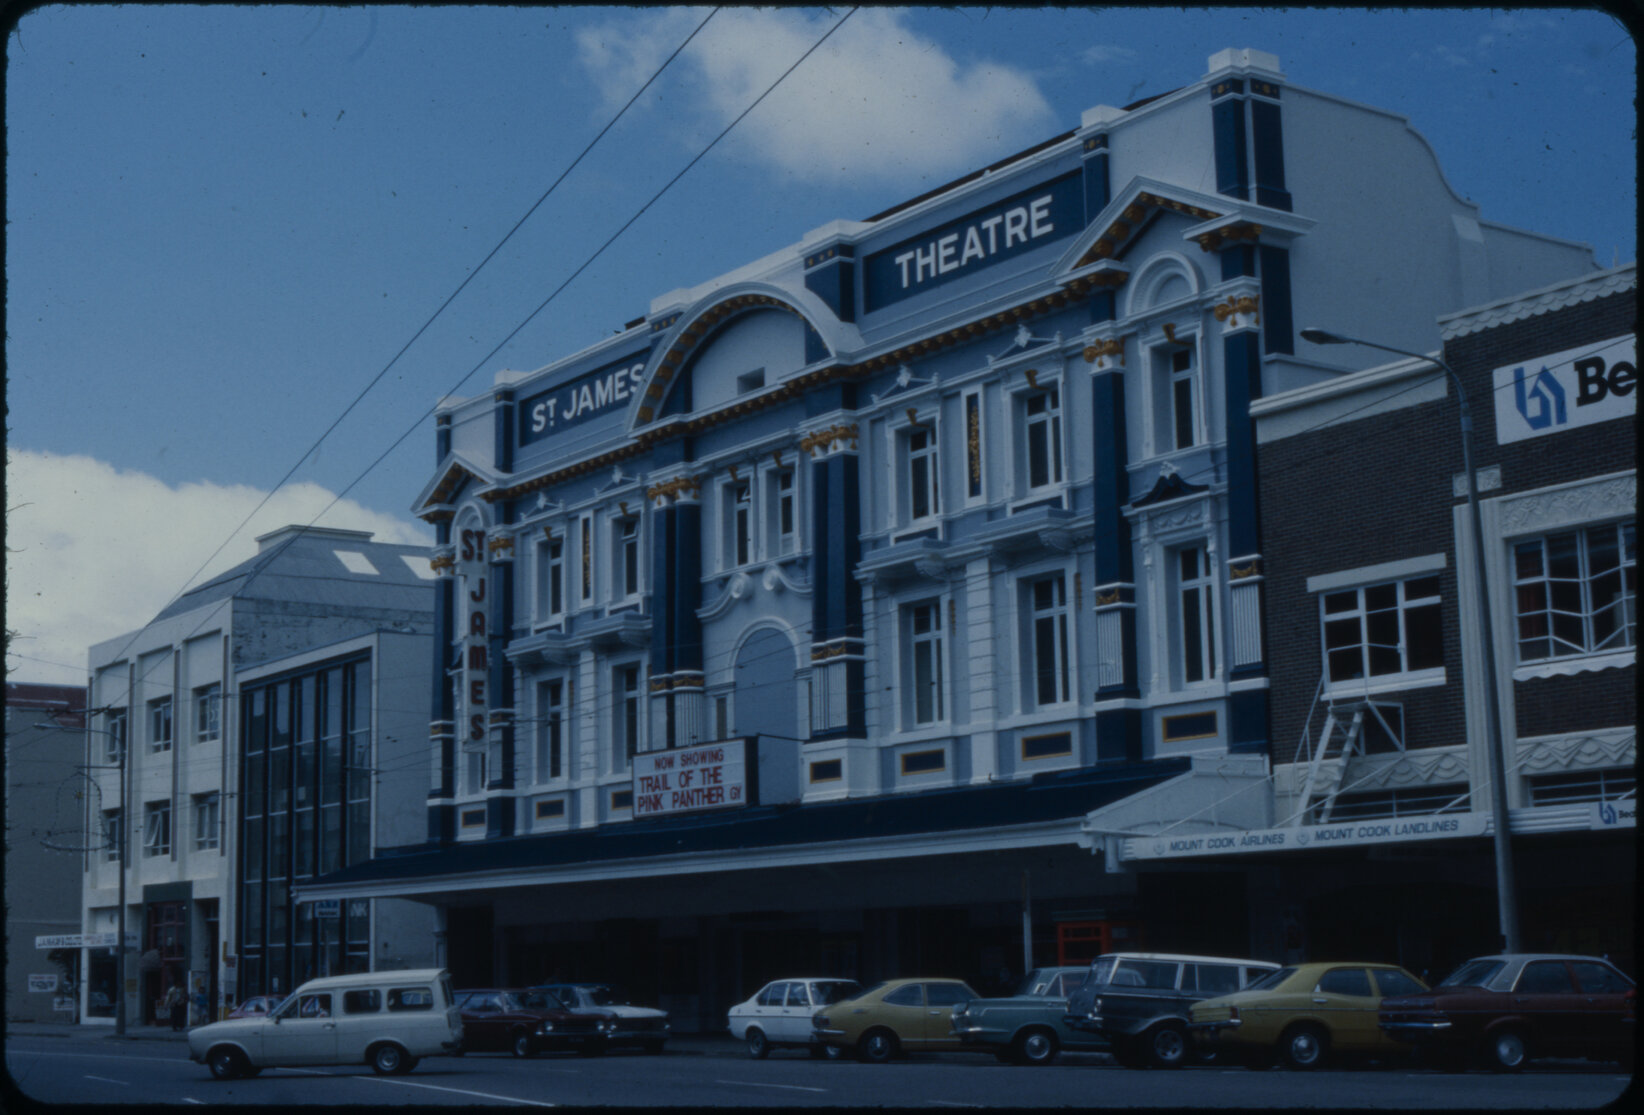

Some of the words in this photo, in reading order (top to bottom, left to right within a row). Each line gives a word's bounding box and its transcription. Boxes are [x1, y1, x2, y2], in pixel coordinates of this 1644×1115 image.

[895, 195, 1054, 289] THEATRE
[563, 363, 645, 420] JAMES
[470, 578, 487, 740] JAMES
[654, 757, 675, 771] NOW
[681, 749, 724, 767] SHOWING
[639, 773, 671, 793] TRAIL
[678, 770, 694, 788] OF
[700, 766, 723, 785] THE
[638, 793, 664, 813] PINK
[672, 786, 725, 809] PANTHER
[1169, 839, 1202, 851] MOUNT
[1207, 837, 1236, 849] COOK
[1240, 833, 1285, 847] AIRLINES
[1314, 828, 1354, 841] MOUNT
[1358, 825, 1391, 838] COOK
[1394, 819, 1459, 833] LANDLINES
